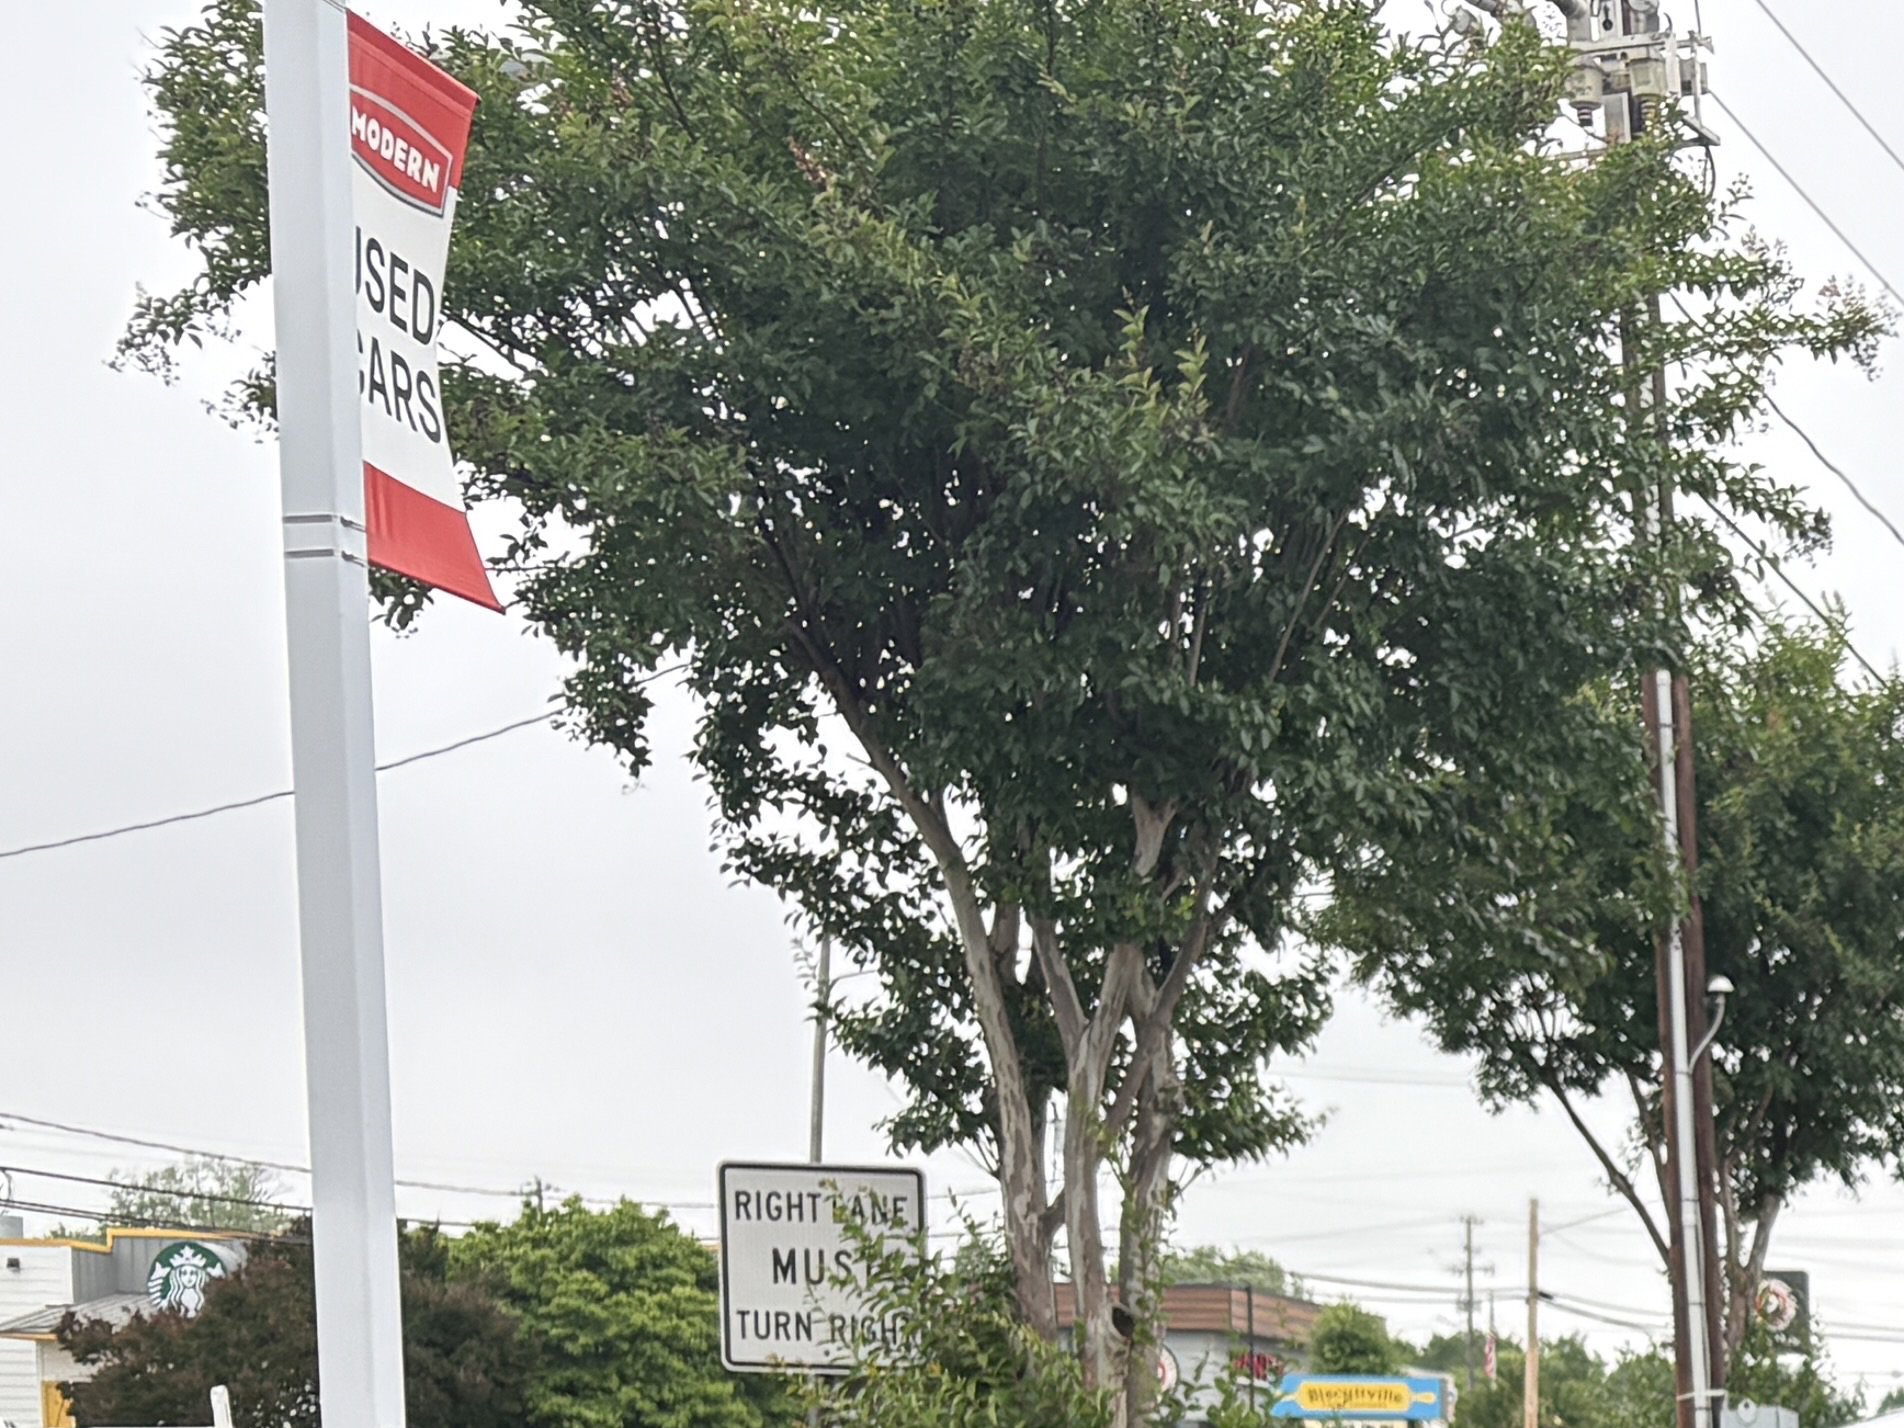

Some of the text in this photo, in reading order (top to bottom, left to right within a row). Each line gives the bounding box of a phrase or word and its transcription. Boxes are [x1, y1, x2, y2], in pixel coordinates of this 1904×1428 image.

[352, 106, 440, 192] MODERN
[357, 328, 441, 443] ARS
[735, 1190, 821, 1223] RIGHT
[736, 1310, 910, 1346] TURN RIGH
